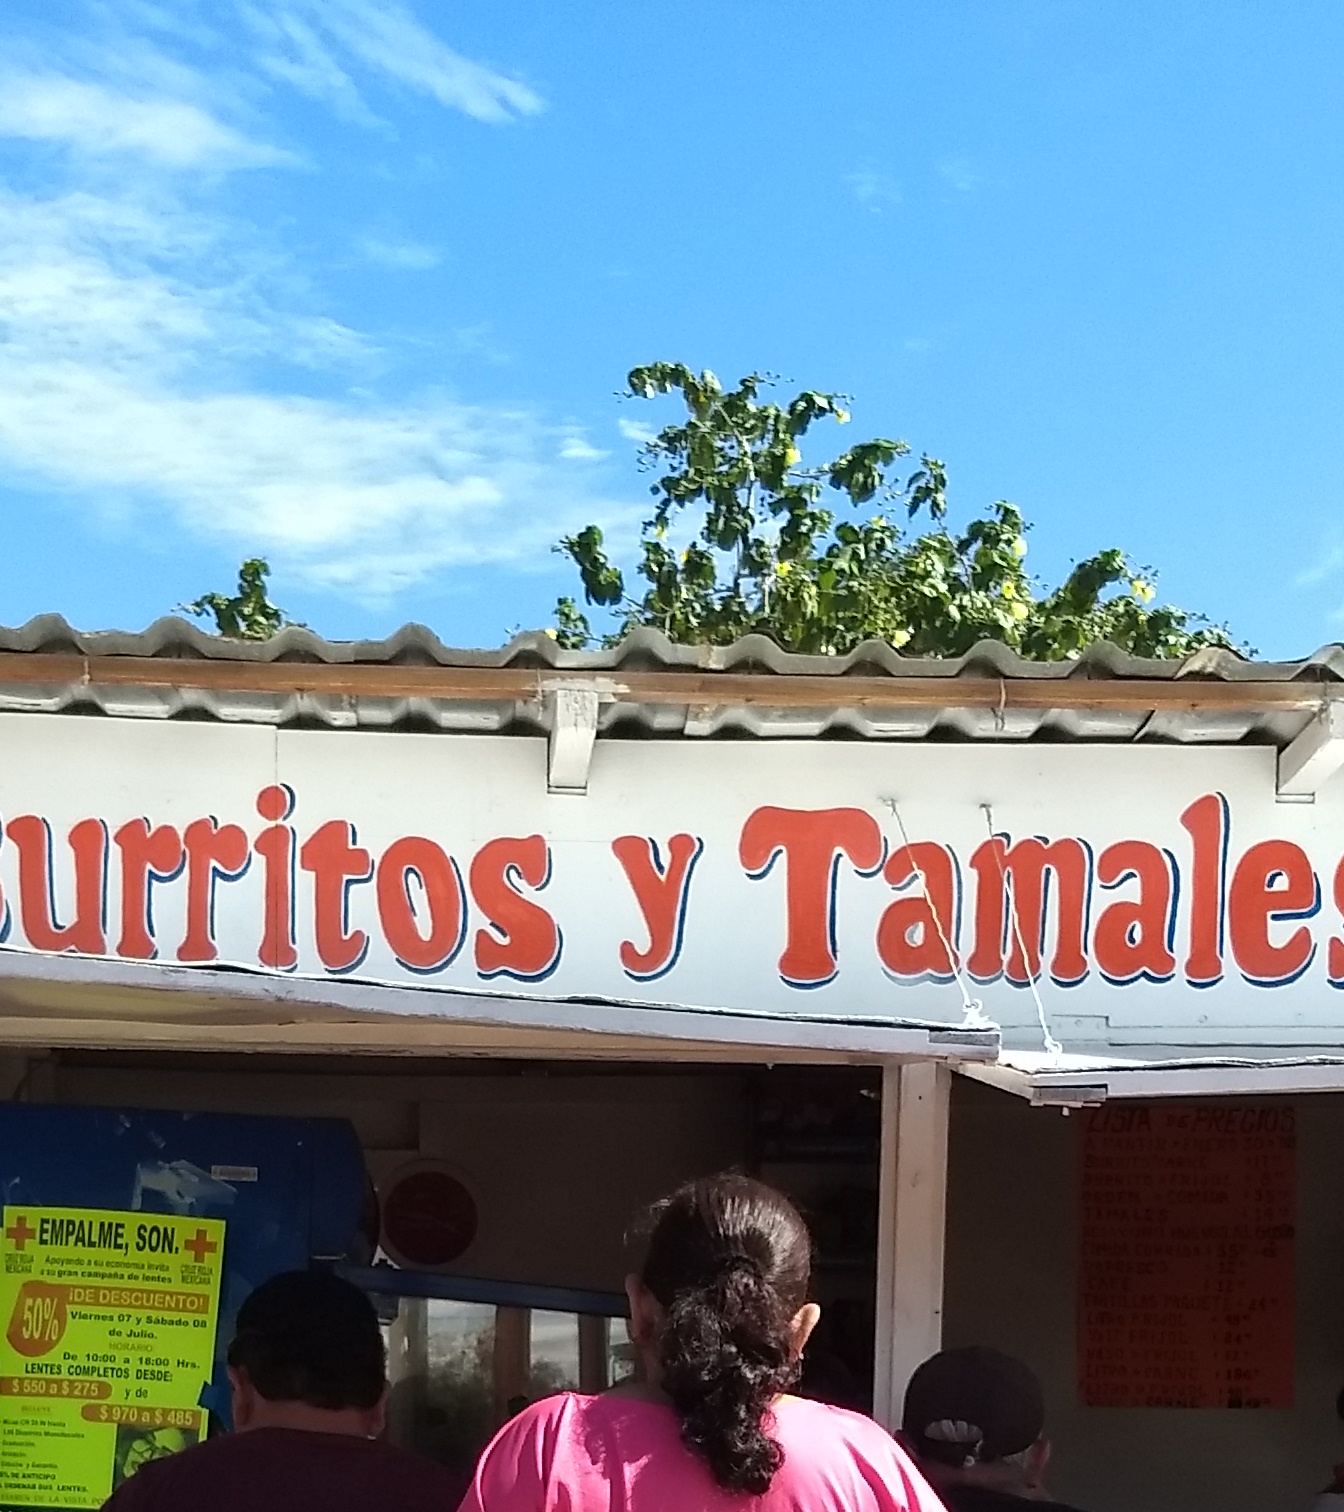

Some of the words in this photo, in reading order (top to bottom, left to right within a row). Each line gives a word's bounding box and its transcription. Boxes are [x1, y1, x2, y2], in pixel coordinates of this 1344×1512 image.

[611, 831, 704, 983] y
[1191, 1106, 1295, 1133] PRECIOS
[39, 1217, 129, 1257] EMPALME,
[136, 1223, 179, 1255] SON.
[45, 1254, 85, 1267] Apoyando
[57, 1270, 78, 1278] gran
[127, 1271, 140, 1281] de
[142, 1273, 172, 1284] lentes
[99, 1289, 204, 1310] DESCUENTO!
[22, 1297, 59, 1341] 50%
[70, 1311, 114, 1321] Viernes
[118, 1313, 131, 1322] 07
[135, 1316, 142, 1326] y
[193, 1319, 207, 1328] 08
[108, 1328, 122, 1337] de
[126, 1328, 157, 1339] Julio.
[109, 1342, 153, 1352] HORARIO
[63, 1351, 78, 1361] De
[85, 1352, 116, 1363] 10:00
[138, 1356, 170, 1367] 18:00
[176, 1358, 201, 1369] Hrs.
[25, 1362, 62, 1375] LENTES
[67, 1364, 130, 1379] COMPLETOS
[136, 1368, 173, 1382] DESDE:
[23, 1380, 46, 1393] 550
[50, 1384, 58, 1394] a
[73, 1382, 99, 1396] 275
[124, 1388, 131, 1400] y
[135, 1387, 148, 1398] de
[112, 1407, 138, 1422] 970
[141, 1411, 150, 1421] a
[167, 1410, 193, 1426] 485
